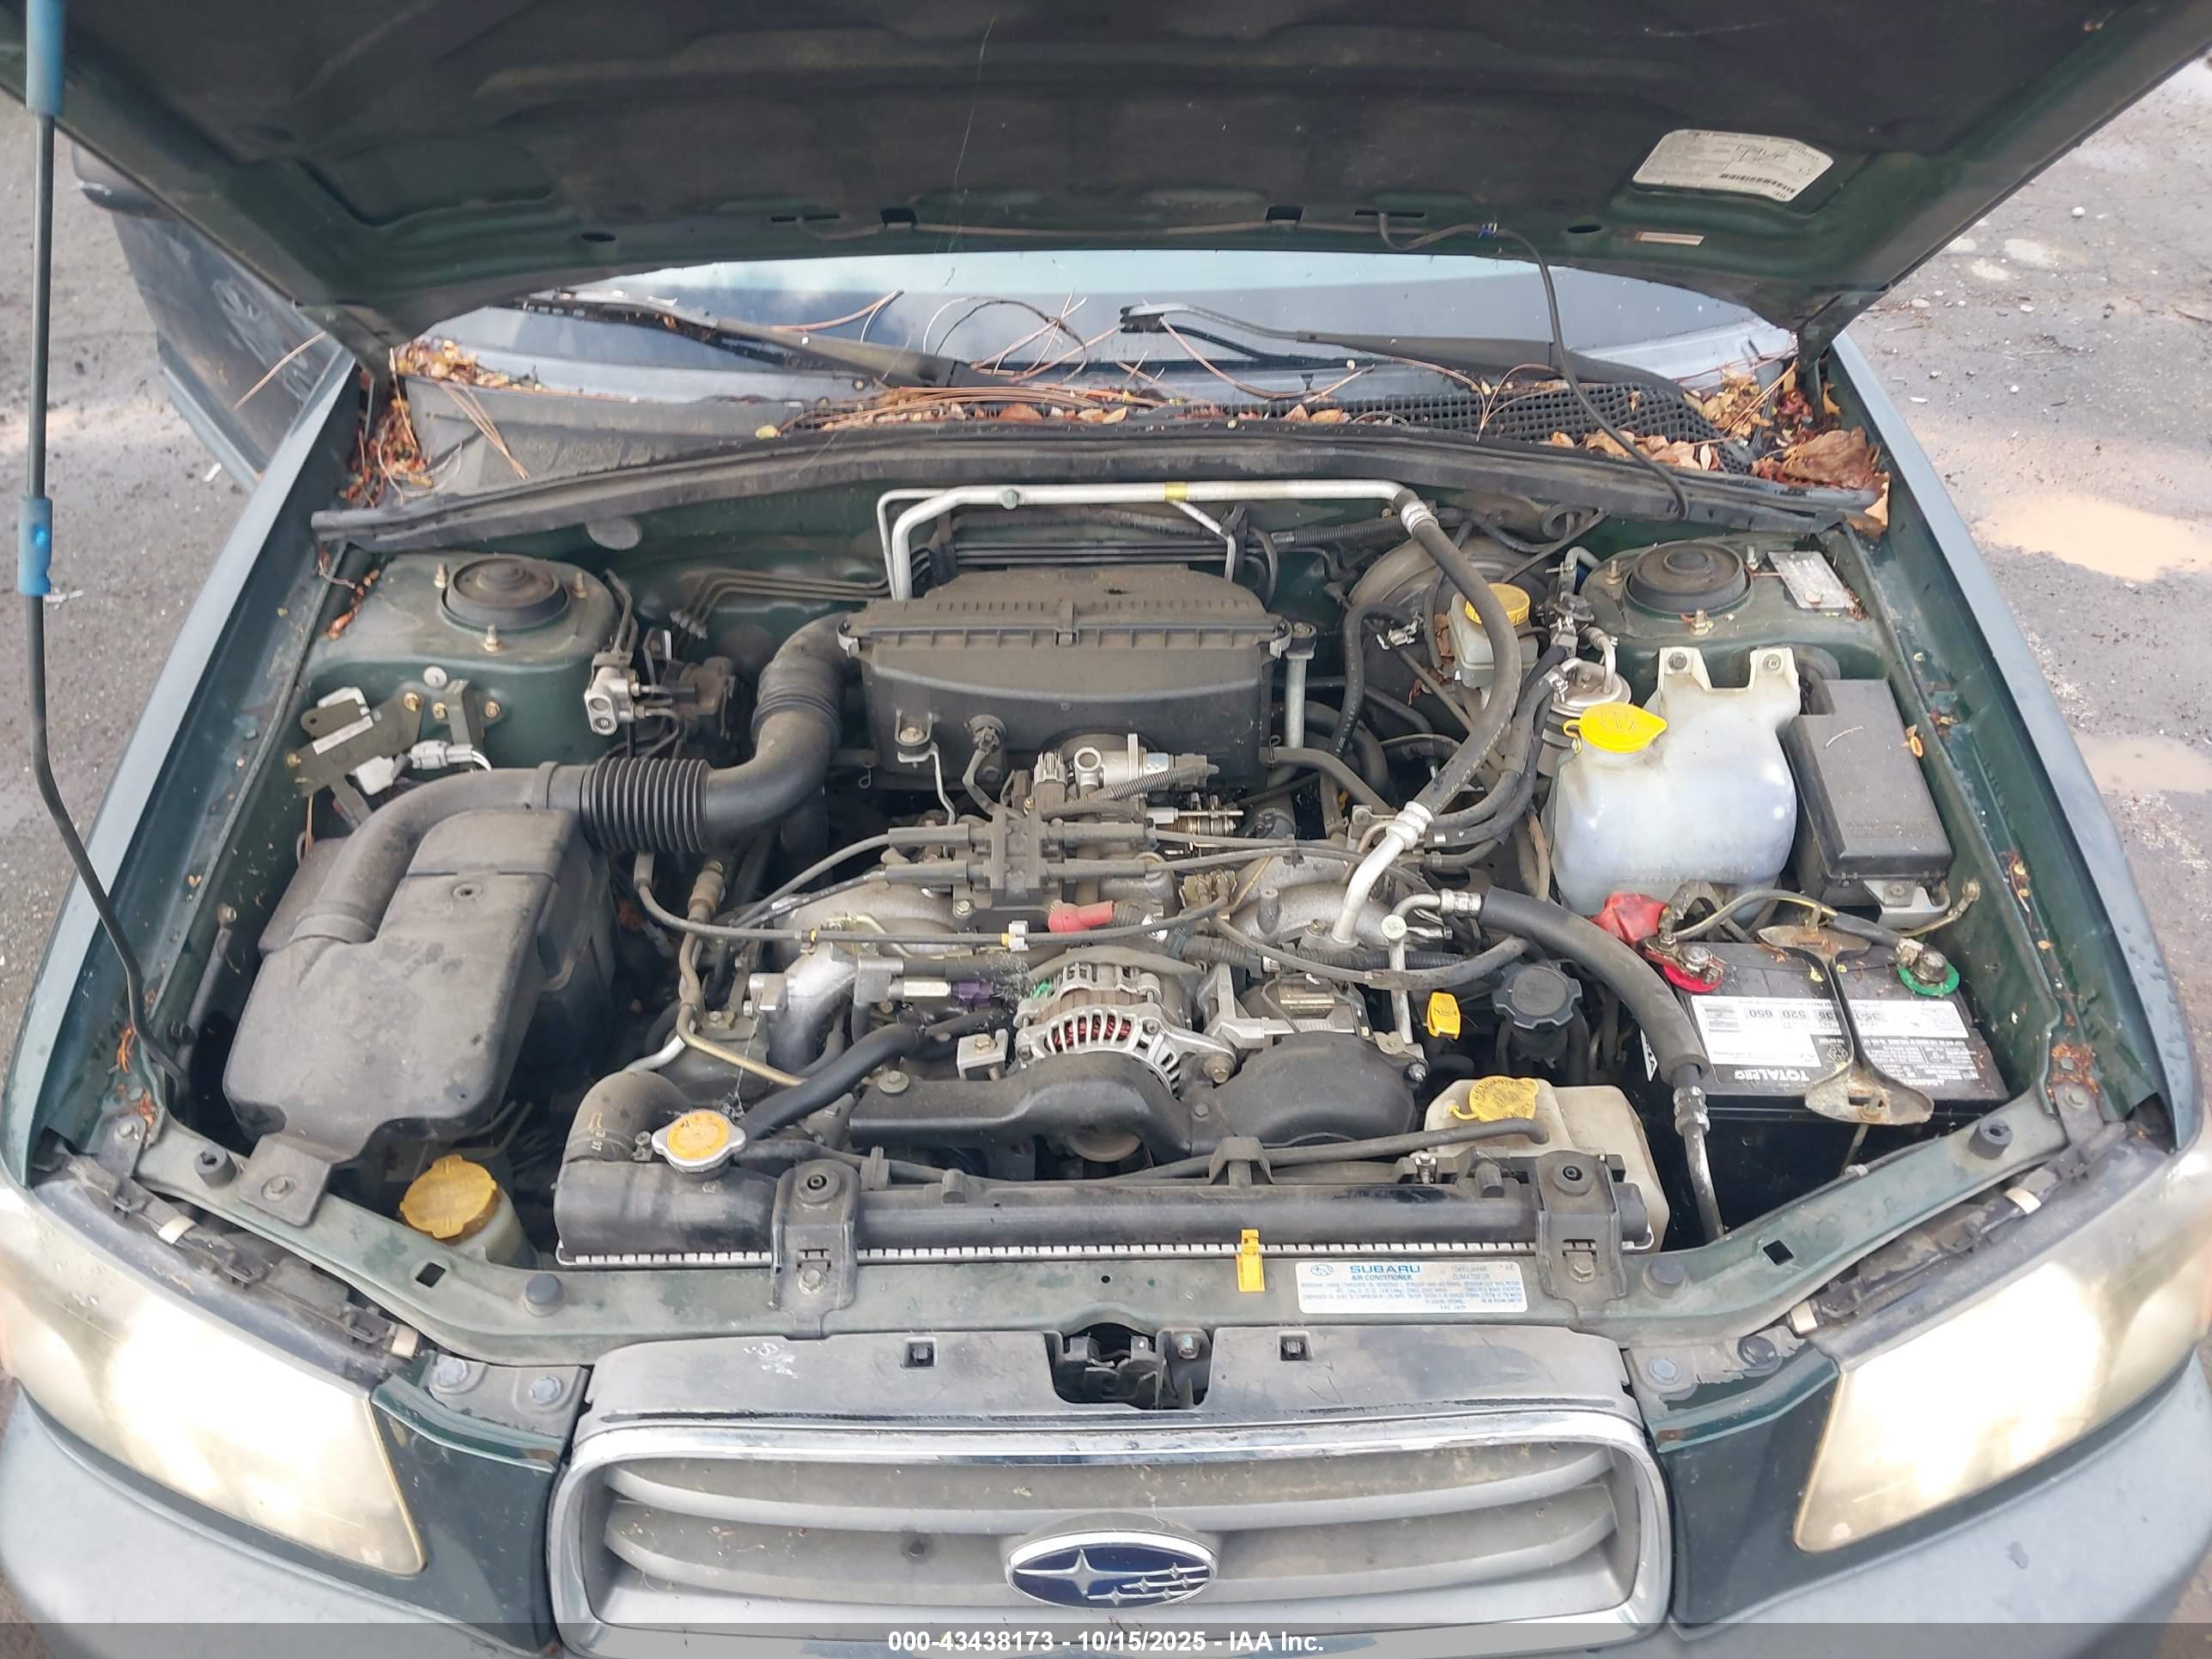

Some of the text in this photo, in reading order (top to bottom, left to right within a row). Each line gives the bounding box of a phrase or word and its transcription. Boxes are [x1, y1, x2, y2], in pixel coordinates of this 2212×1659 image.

[1748, 1009, 1773, 1019] 650
[1782, 1010, 1807, 1019] 520
[1350, 1265, 1421, 1273] SUBARU
